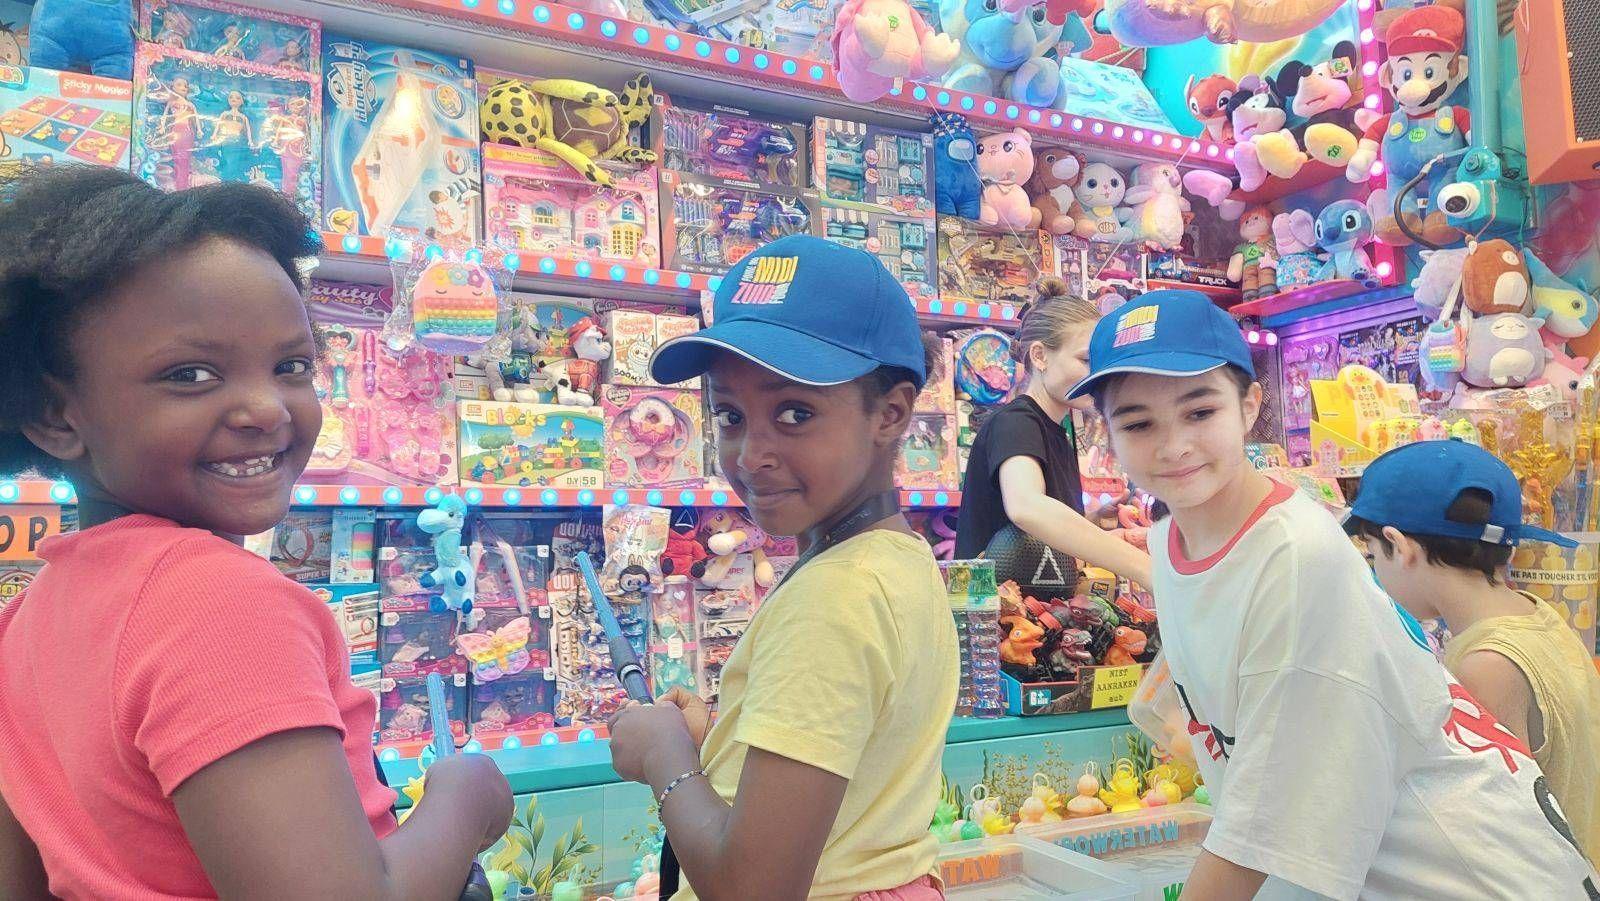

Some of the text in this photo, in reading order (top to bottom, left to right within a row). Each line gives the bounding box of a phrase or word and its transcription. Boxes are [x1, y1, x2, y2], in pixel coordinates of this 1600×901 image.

[752, 255, 799, 283] MIDI
[1198, 276, 1228, 286] TRUCK
[486, 407, 547, 426] Blocks
[582, 477, 597, 486] 58
[1522, 571, 1537, 580] PAS
[1539, 572, 1576, 581] TOUCHER
[1109, 668, 1128, 678] NIET
[1096, 680, 1138, 692] AANRAKEN
[1108, 694, 1123, 703] aub
